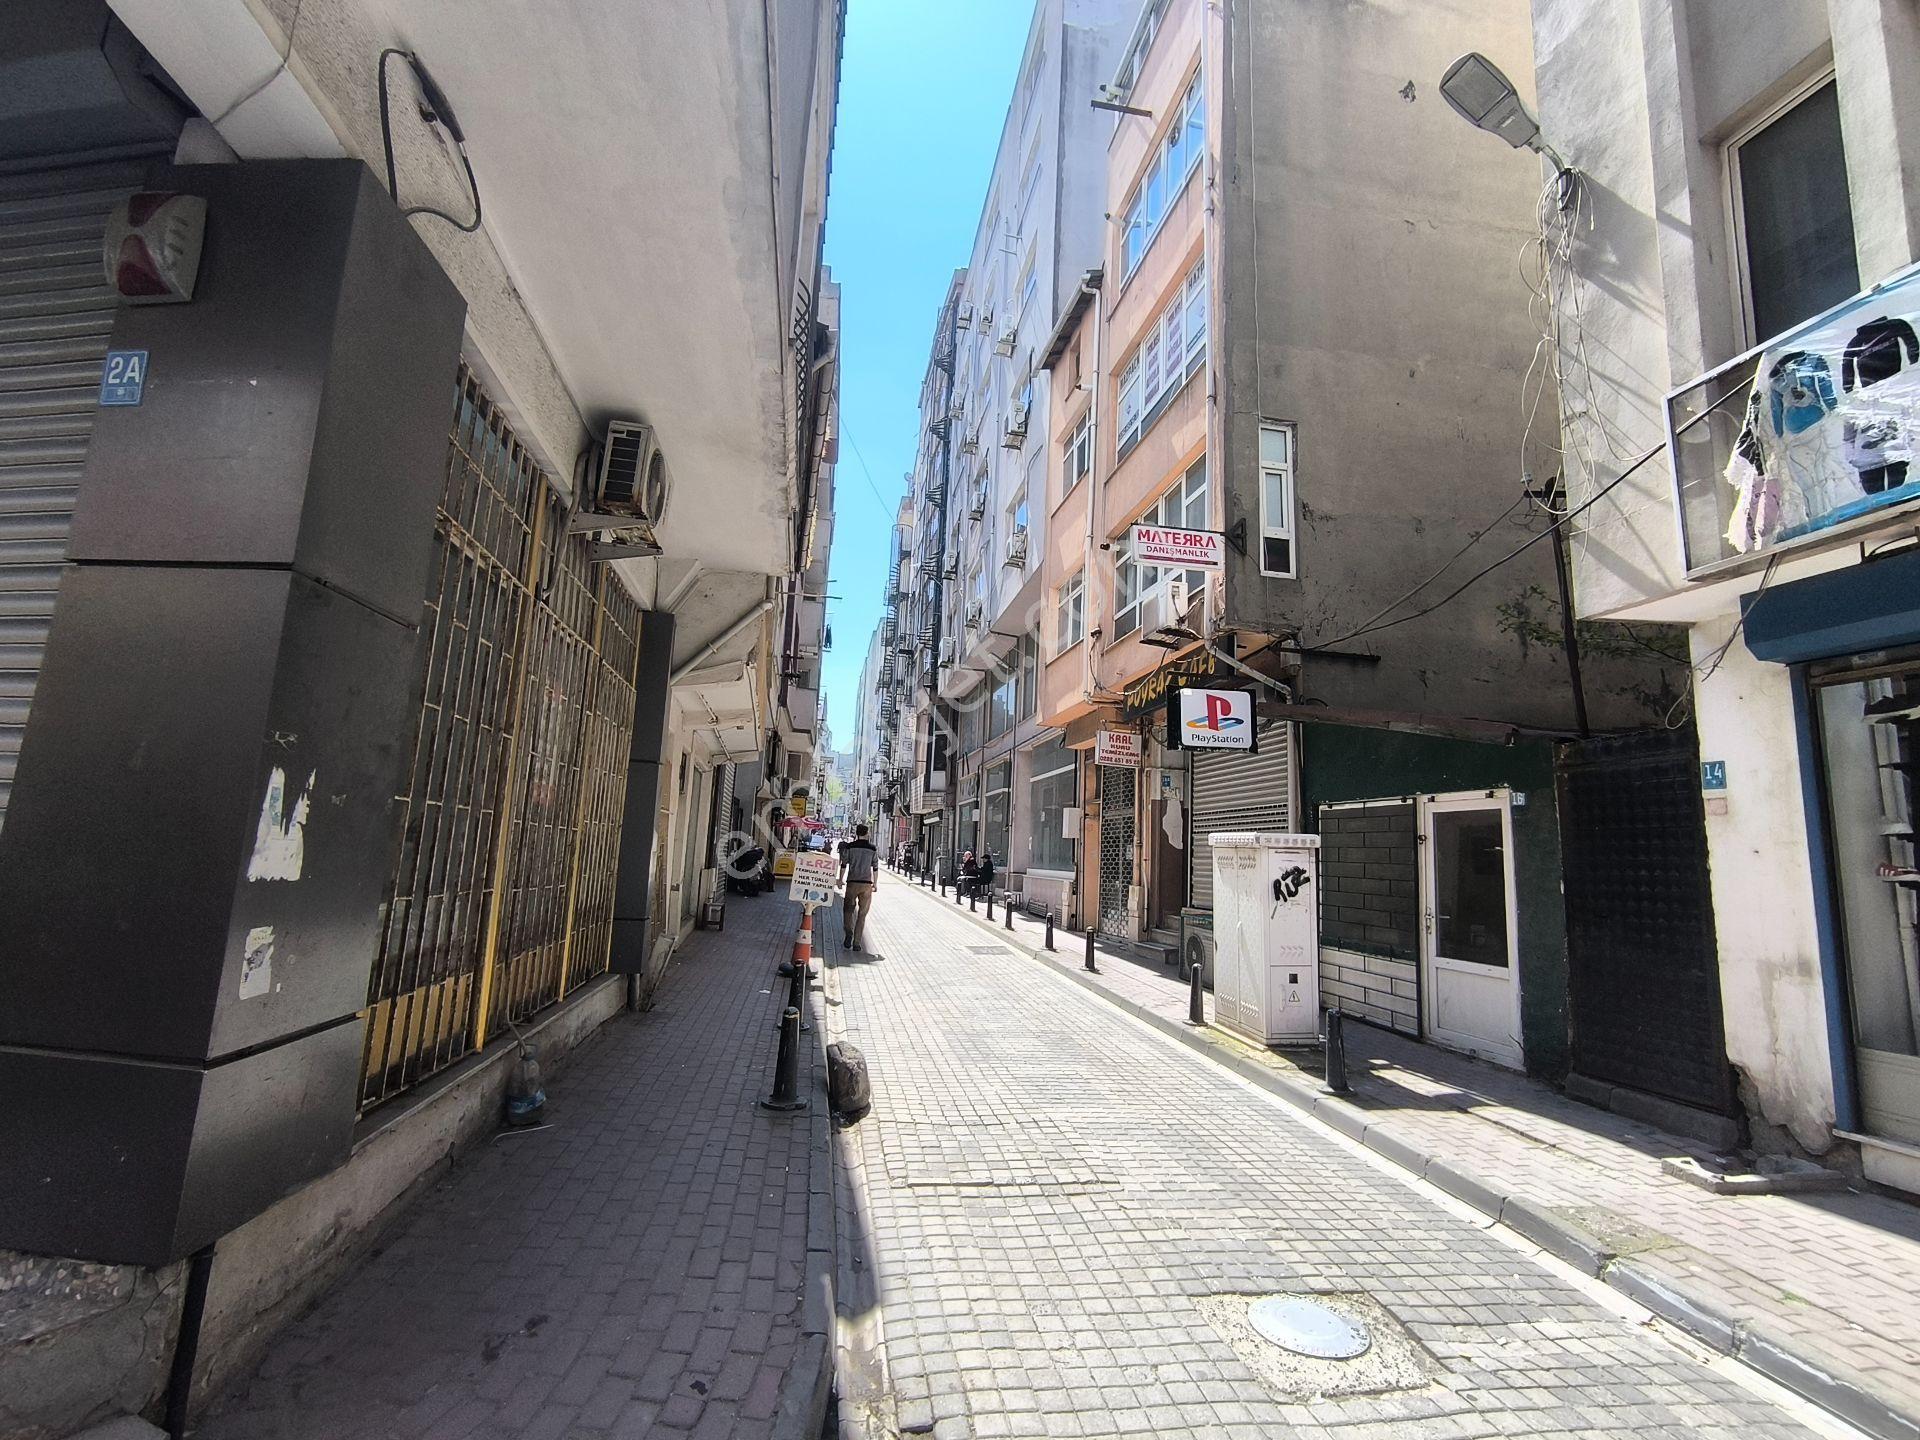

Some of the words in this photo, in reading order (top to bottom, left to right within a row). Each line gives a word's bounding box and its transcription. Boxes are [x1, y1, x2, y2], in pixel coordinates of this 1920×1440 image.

[108, 356, 139, 383] 2A
[1137, 529, 1217, 549] MATERRA
[1146, 545, 1210, 559] DANIŞMANLIK
[1108, 734, 1133, 745] KRAL
[1191, 733, 1244, 745] PlayStation
[1705, 764, 1722, 779] 14
